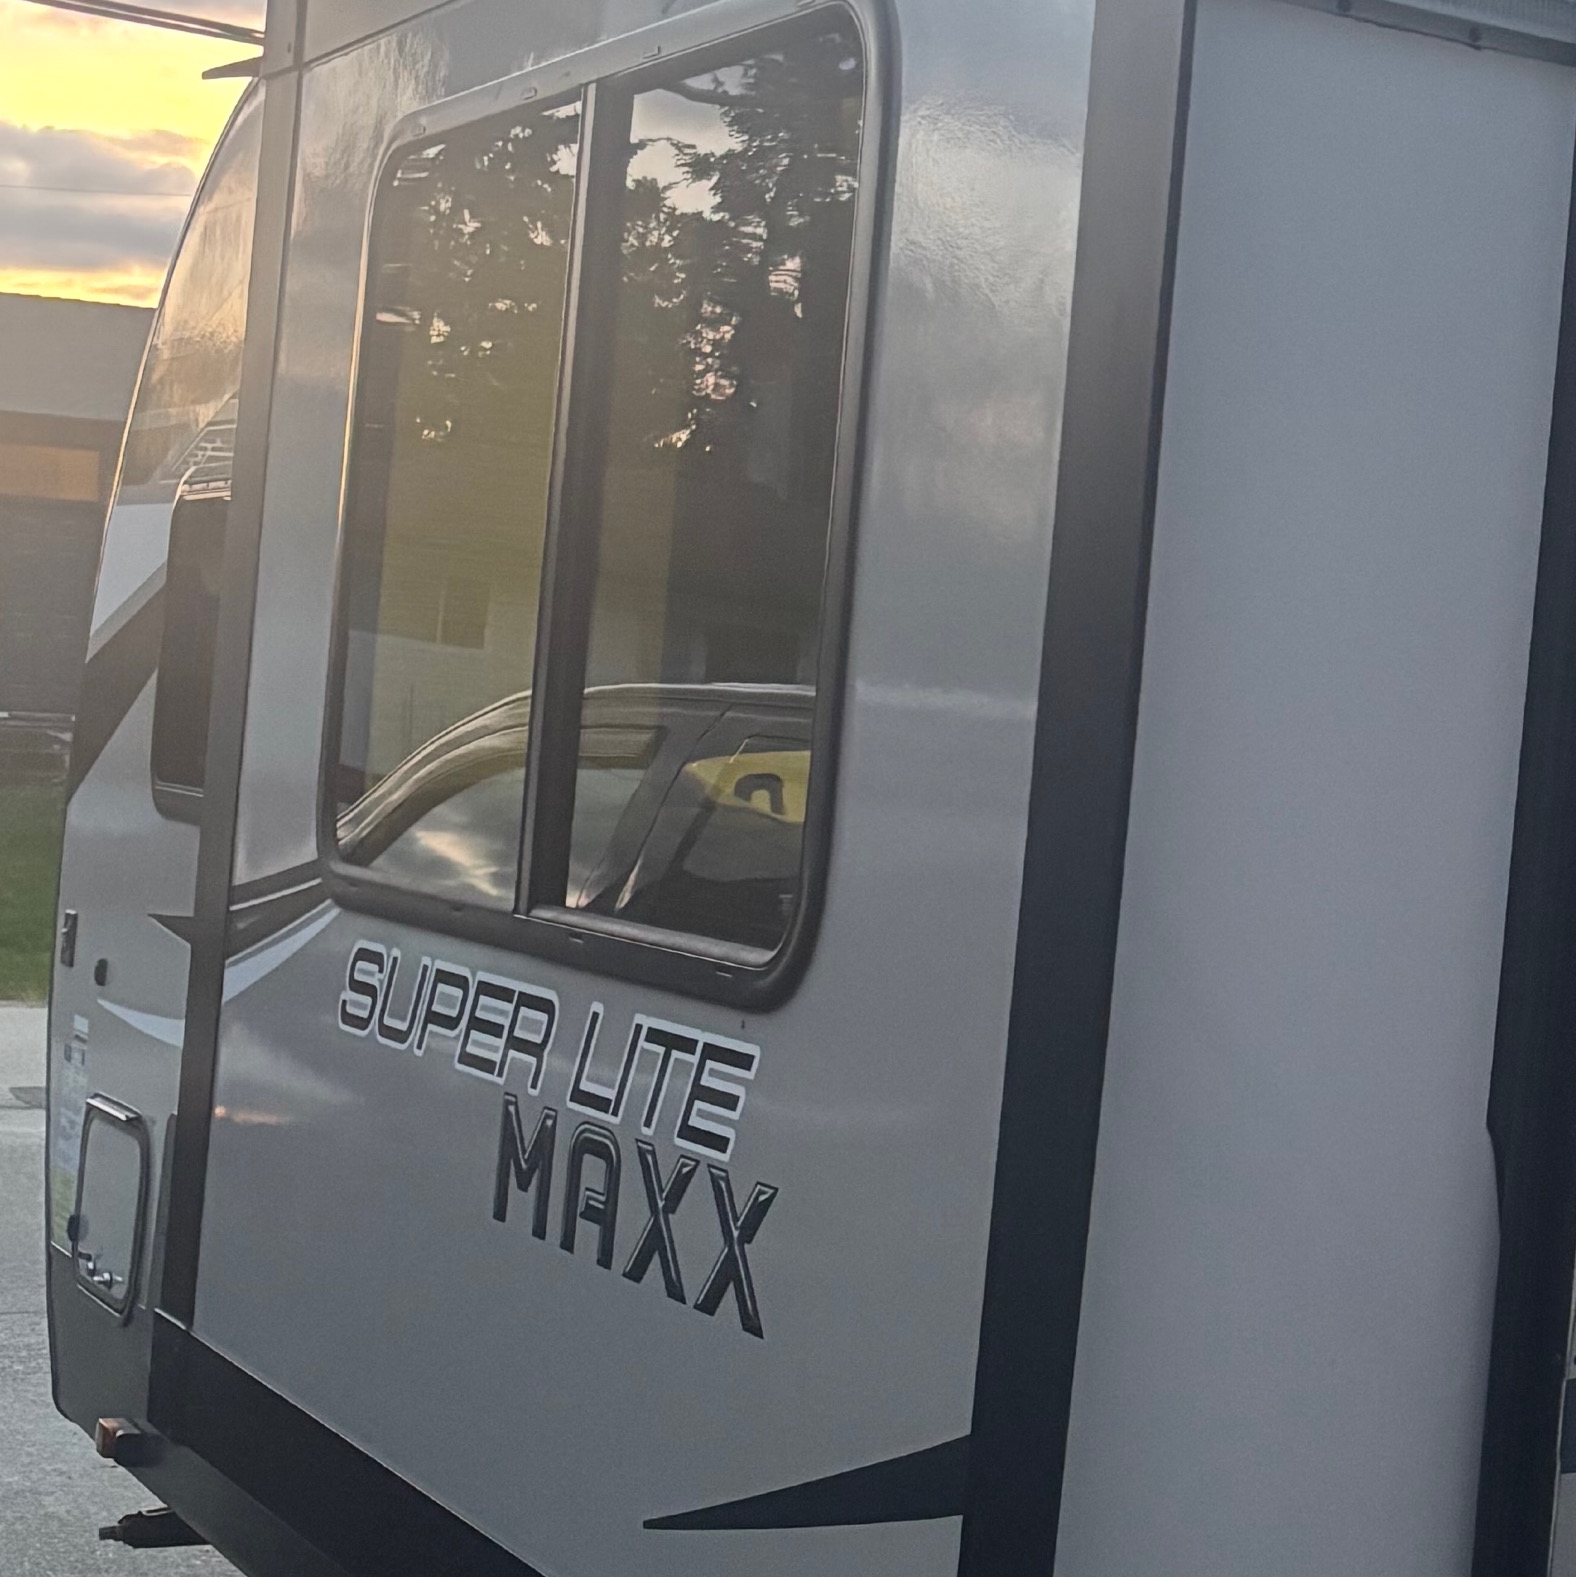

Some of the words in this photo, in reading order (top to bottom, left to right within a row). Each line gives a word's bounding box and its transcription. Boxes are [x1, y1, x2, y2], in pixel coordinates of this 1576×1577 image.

[338, 940, 559, 1096] SUPER
[567, 1002, 761, 1162] LITE
[493, 1093, 779, 1340] MAXX
